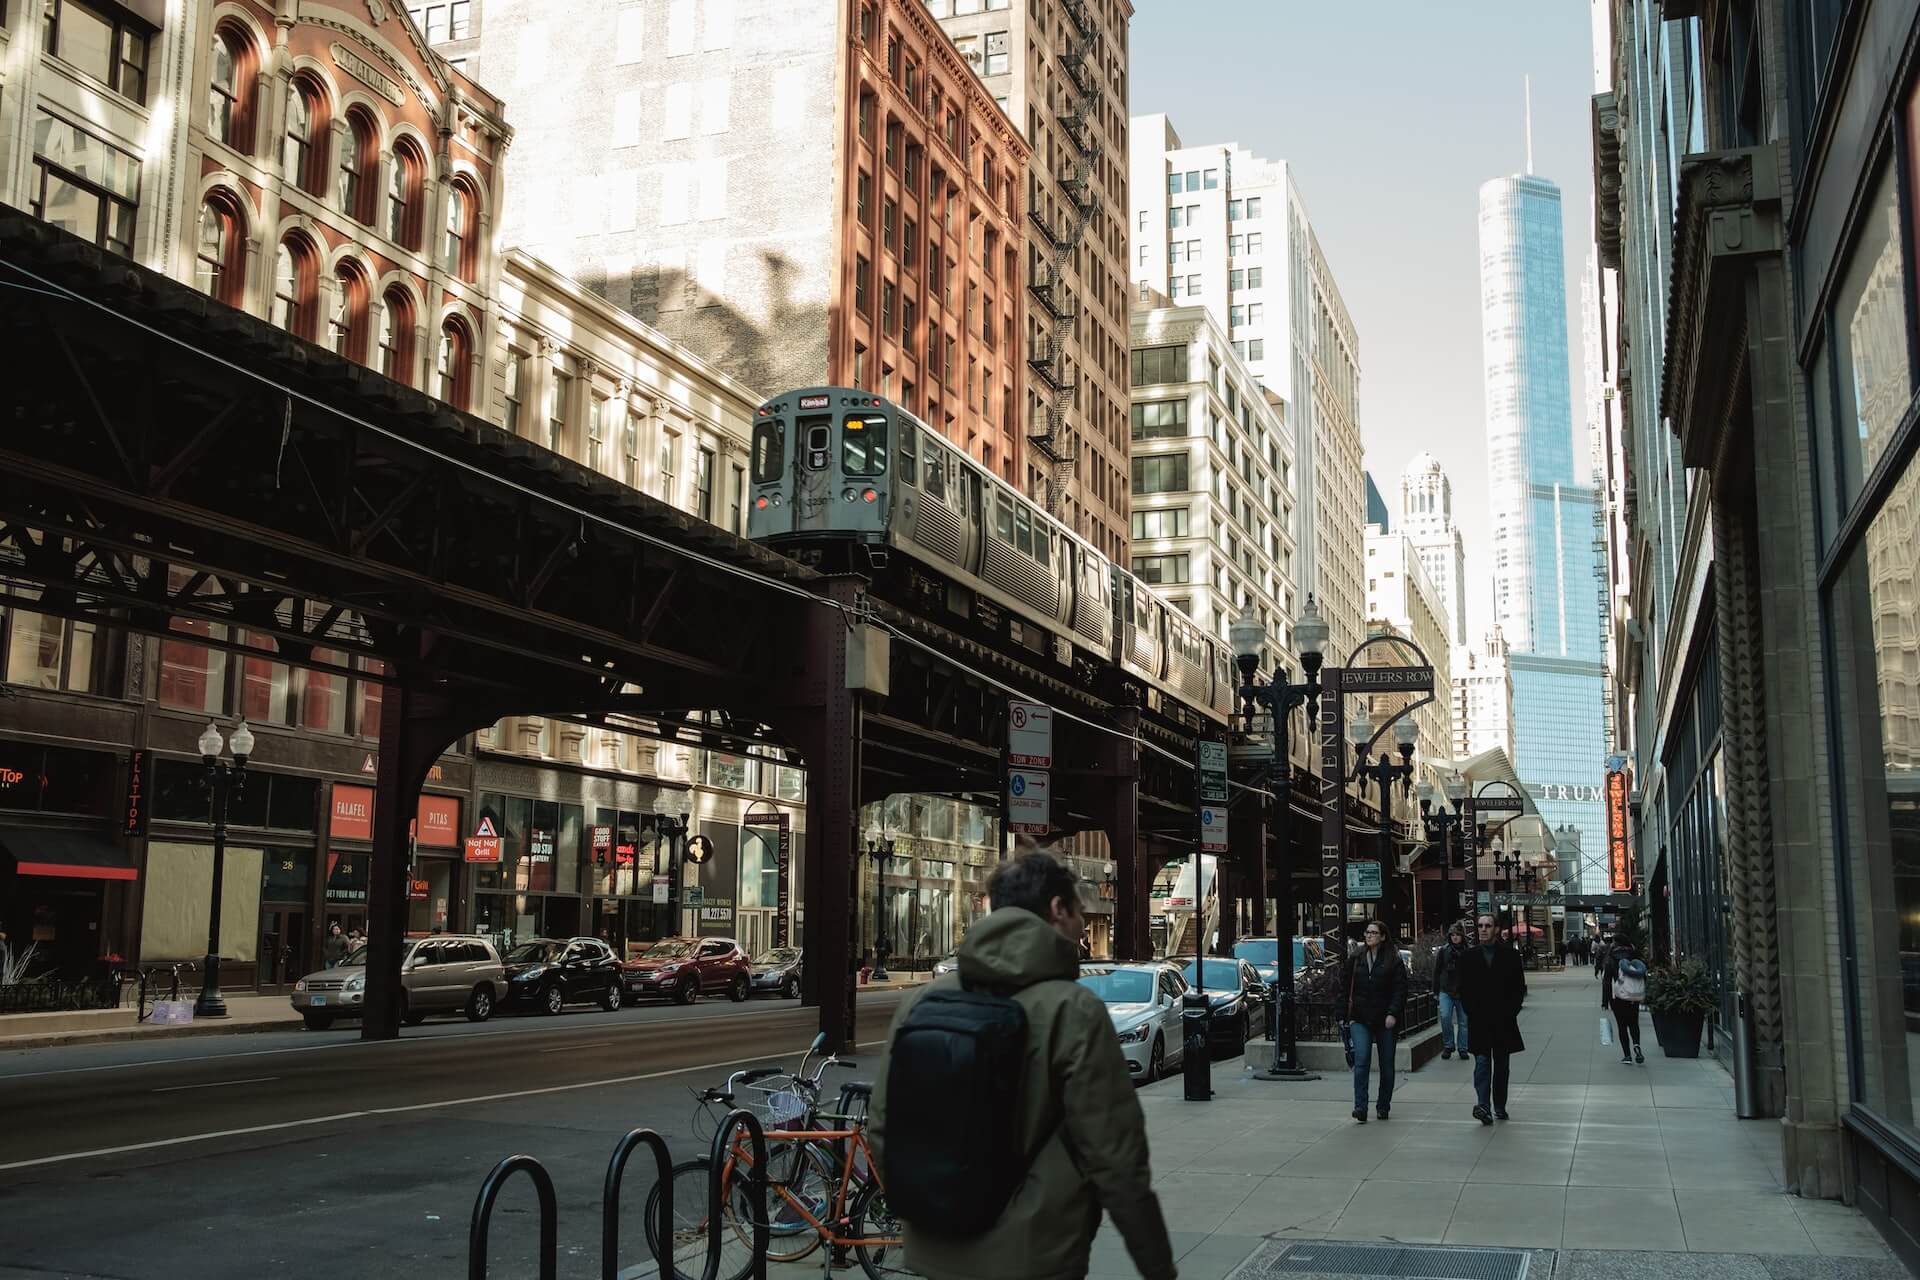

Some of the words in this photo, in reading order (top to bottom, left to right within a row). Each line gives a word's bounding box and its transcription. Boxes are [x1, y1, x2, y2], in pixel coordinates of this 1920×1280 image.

[1341, 672, 1403, 684] JEWELERS
[1406, 671, 1433, 682] ROW
[1320, 689, 1340, 813] AVENUE
[1013, 755, 1027, 764] TOW
[1029, 756, 1046, 765] ZONE
[1540, 784, 1604, 801] TRUM
[337, 802, 366, 817] FALAFEL
[429, 812, 448, 825] PITAS
[594, 827, 610, 835] GOOD
[1012, 824, 1025, 832] TOW
[1027, 825, 1044, 833] ZONE
[468, 839, 482, 849] Naf
[483, 839, 498, 849] Naf
[1464, 808, 1474, 874] AVENUE
[474, 848, 490, 856] Grill
[780, 823, 789, 879] AVENUE
[281, 860, 294, 871] 28
[342, 864, 353, 874] 28
[1322, 844, 1341, 968] WABASH
[779, 891, 788, 949] WABASH
